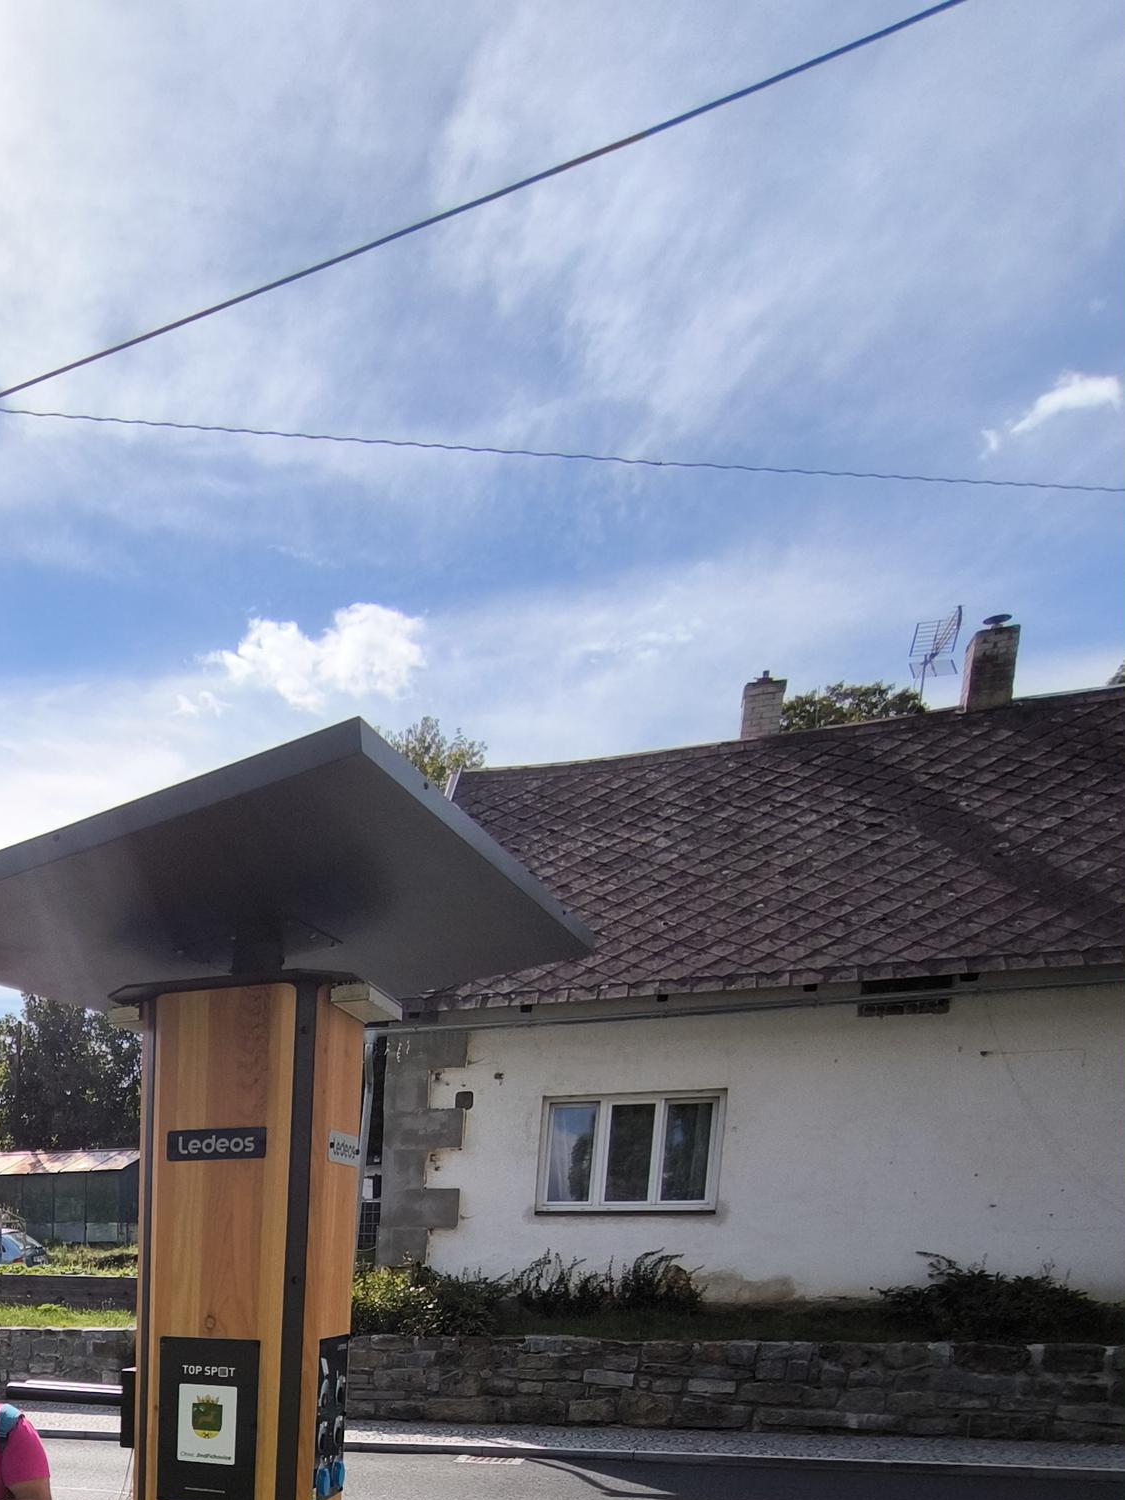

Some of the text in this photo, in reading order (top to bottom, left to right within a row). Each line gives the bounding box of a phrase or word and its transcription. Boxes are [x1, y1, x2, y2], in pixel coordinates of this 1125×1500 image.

[178, 1134, 255, 1154] Ledeos
[182, 1364, 236, 1378] TOP SPOT
